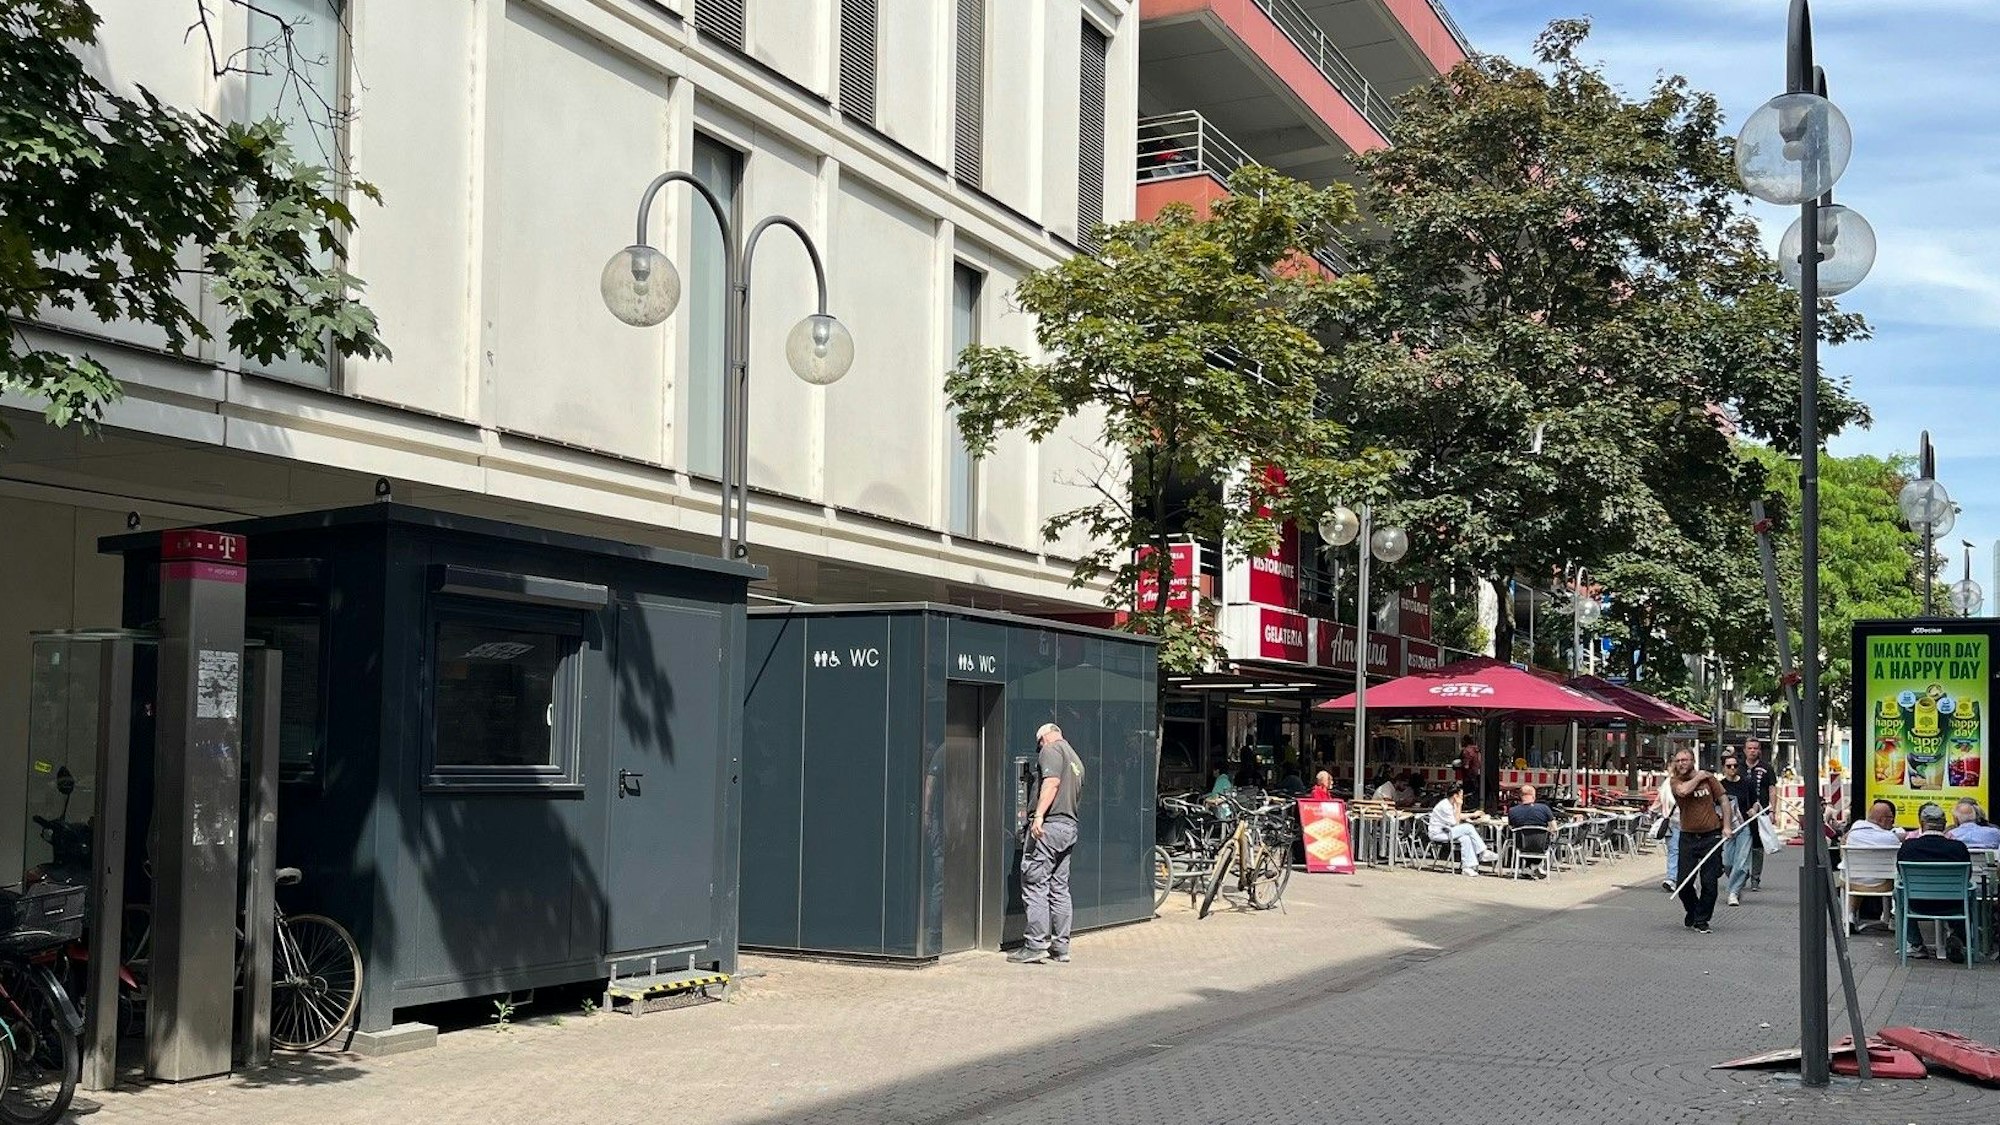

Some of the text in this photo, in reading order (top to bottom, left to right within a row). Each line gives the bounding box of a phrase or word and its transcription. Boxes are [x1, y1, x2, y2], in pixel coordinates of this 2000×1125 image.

[1253, 556, 1294, 579] RISTORANTE
[1264, 624, 1303, 648] GELATERIA
[1874, 643, 1982, 658] MAKE YOUR DAY
[850, 648, 879, 667] WC
[979, 655, 996, 673] WC
[1874, 661, 1980, 679] A HAPPY DAY
[1428, 686, 1494, 695] COSTA
[1427, 721, 1457, 731] SALE
[1875, 718, 1905, 730] happy
[1949, 718, 1979, 731] happy
[1880, 725, 1900, 738] day
[1954, 725, 1973, 738] day
[1914, 744, 1939, 755] day
